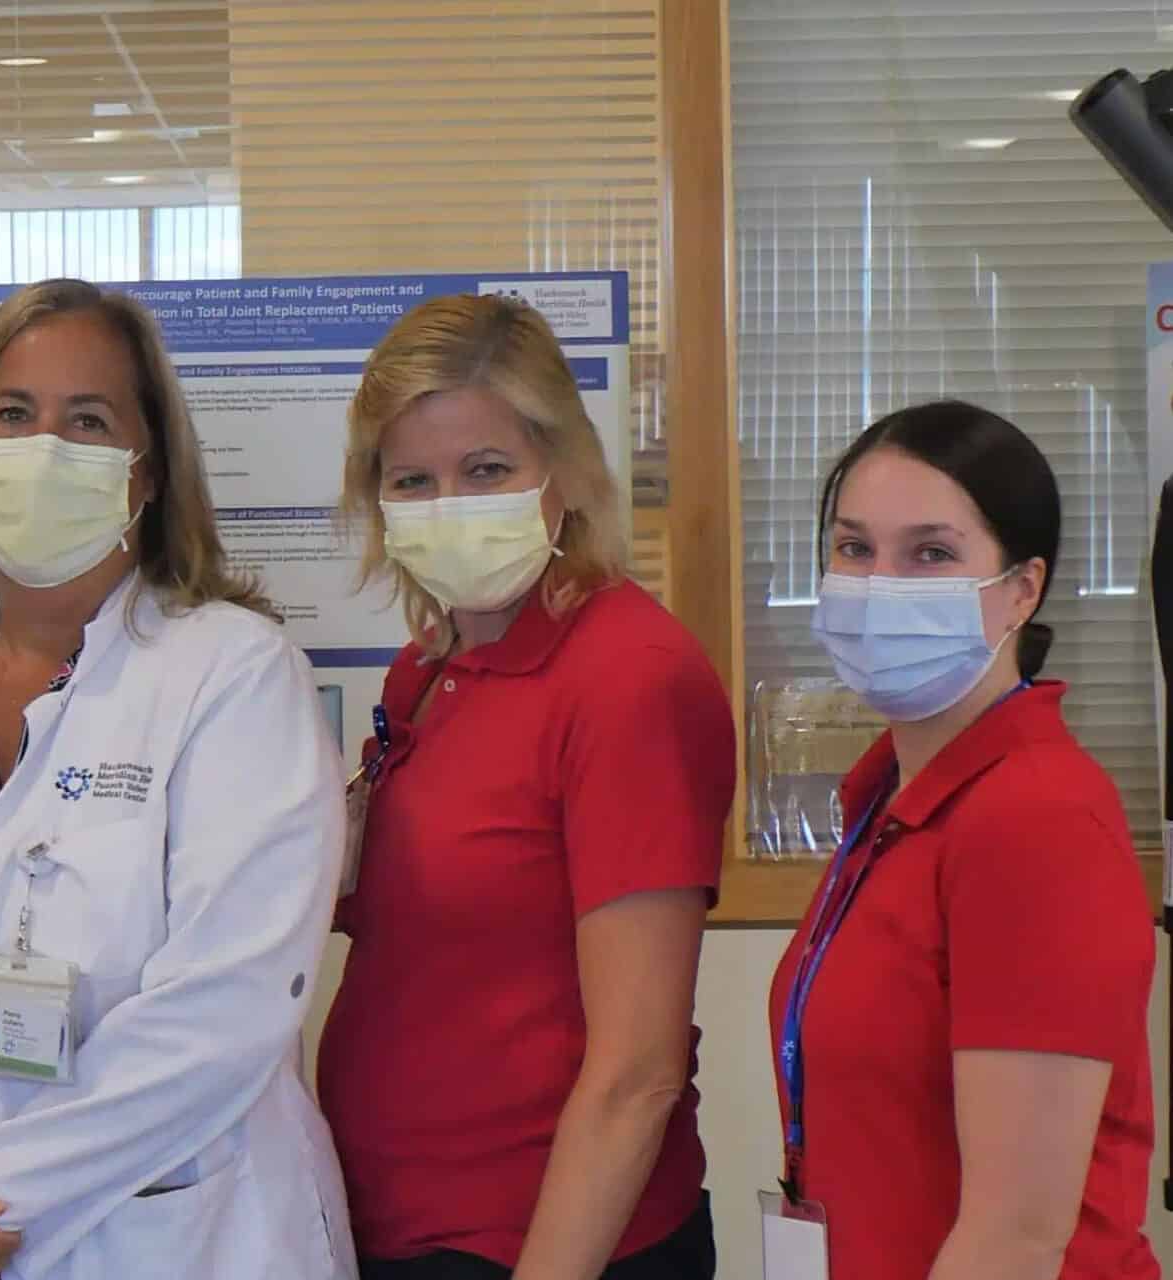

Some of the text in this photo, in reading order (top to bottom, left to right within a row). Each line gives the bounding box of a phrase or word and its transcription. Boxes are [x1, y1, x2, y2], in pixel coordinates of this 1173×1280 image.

[195, 287, 241, 299] Patient
[244, 286, 269, 298] and
[272, 286, 313, 299] Family
[316, 284, 395, 299] Engagement
[399, 283, 424, 295] and
[181, 307, 194, 319] in
[196, 306, 228, 318] Total
[230, 305, 262, 318] Joint
[265, 304, 349, 318] Replacement
[352, 303, 403, 315] Patients
